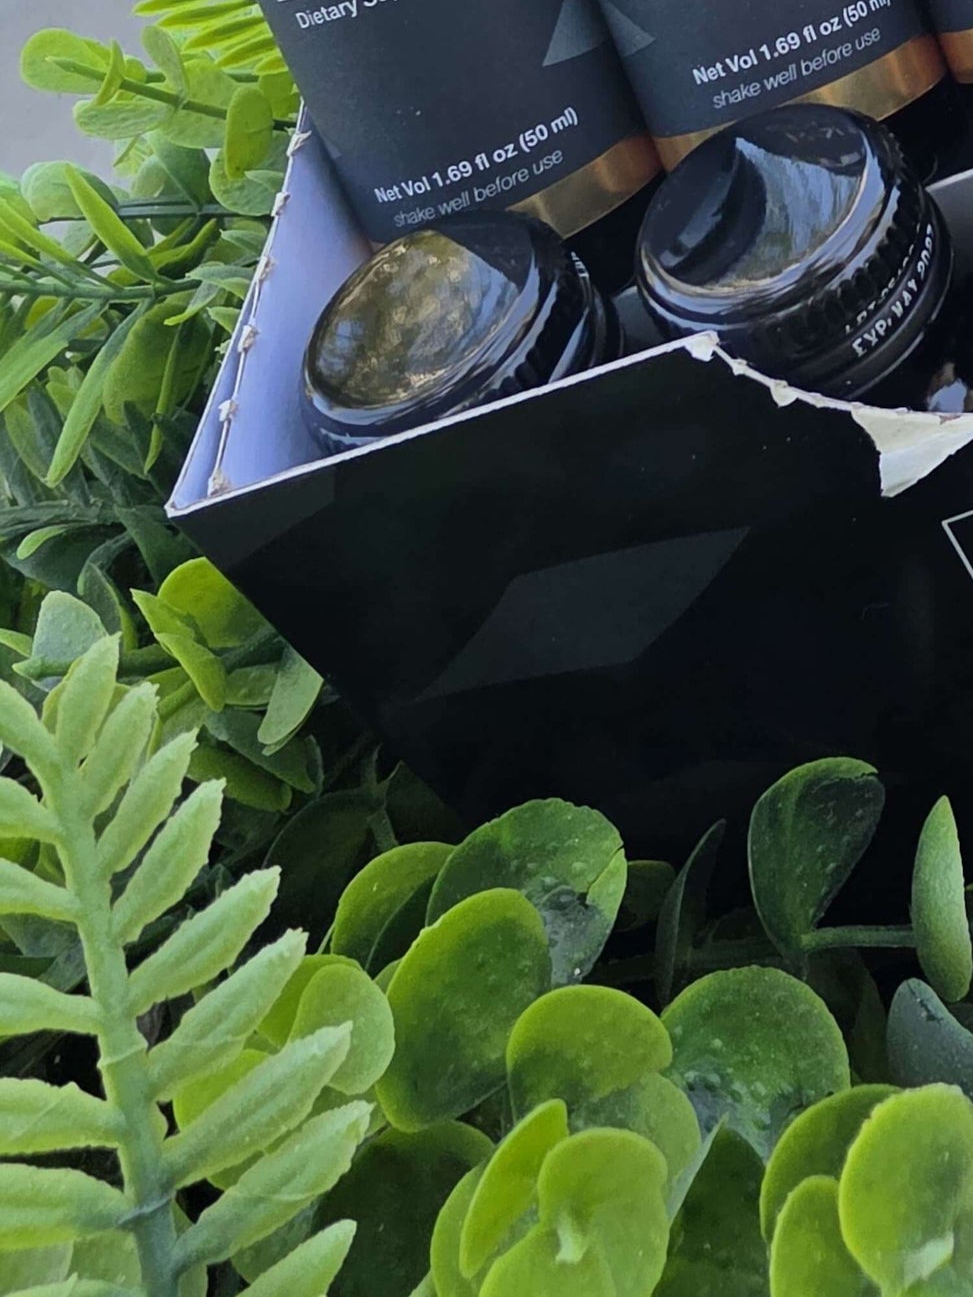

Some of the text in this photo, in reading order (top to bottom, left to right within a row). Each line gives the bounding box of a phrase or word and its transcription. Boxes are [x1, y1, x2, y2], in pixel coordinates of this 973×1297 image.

[692, 62, 726, 85] Net
[725, 50, 758, 73] Vol
[760, 32, 800, 61] 1.69
[803, 25, 817, 43] fl
[820, 17, 842, 36] oz
[843, 1, 868, 27] (50
[713, 27, 881, 109] shake well before use
[374, 107, 578, 203] Net Vol 1.69 fl oz (50 ml)
[393, 150, 564, 227] shake well before use
